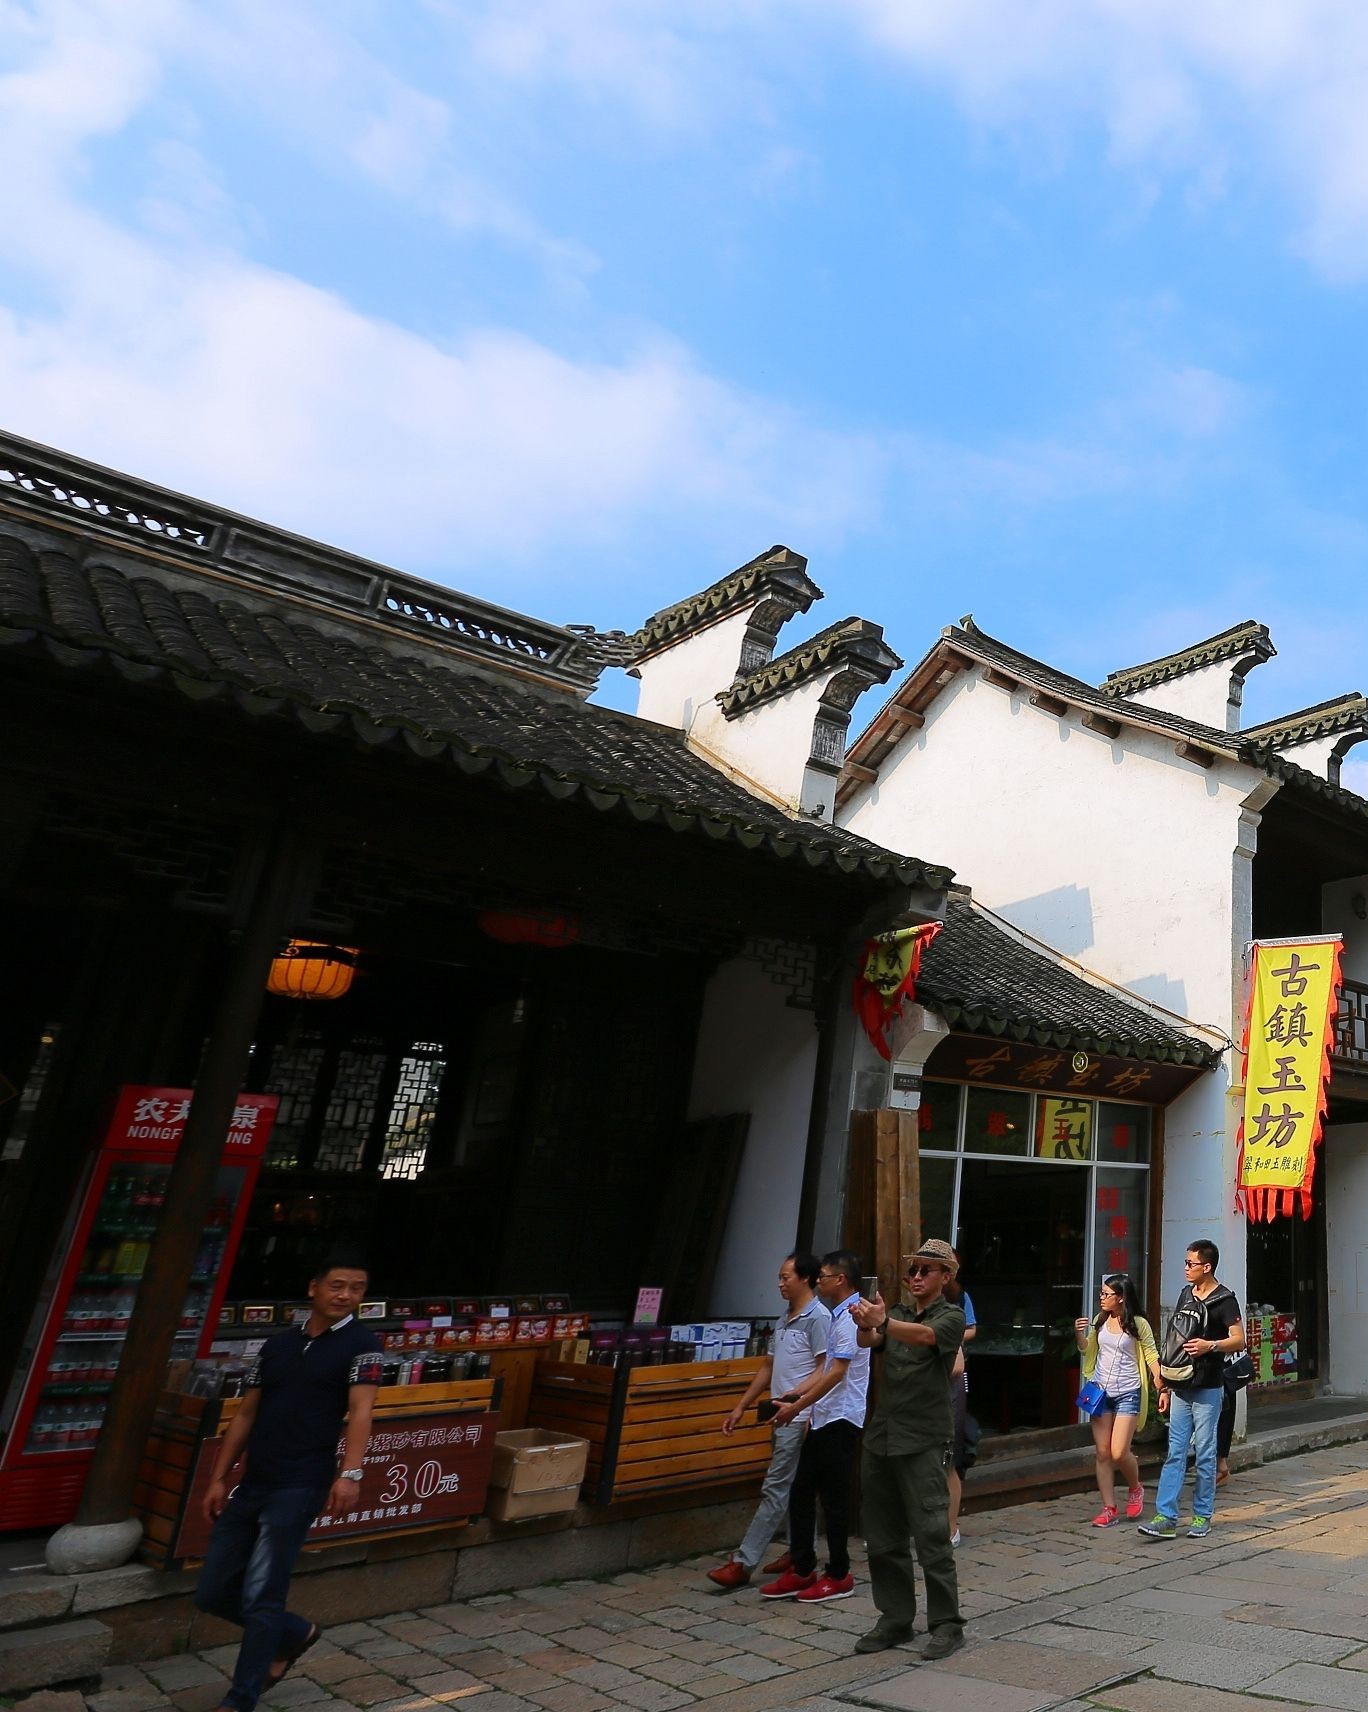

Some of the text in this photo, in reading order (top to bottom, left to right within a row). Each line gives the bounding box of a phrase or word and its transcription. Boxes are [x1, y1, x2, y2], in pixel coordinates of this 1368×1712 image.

[1248, 953, 1321, 1150] 古鎮玉坊
[133, 1097, 261, 1130] 农夫泉
[126, 1125, 252, 1145] NONGF ING
